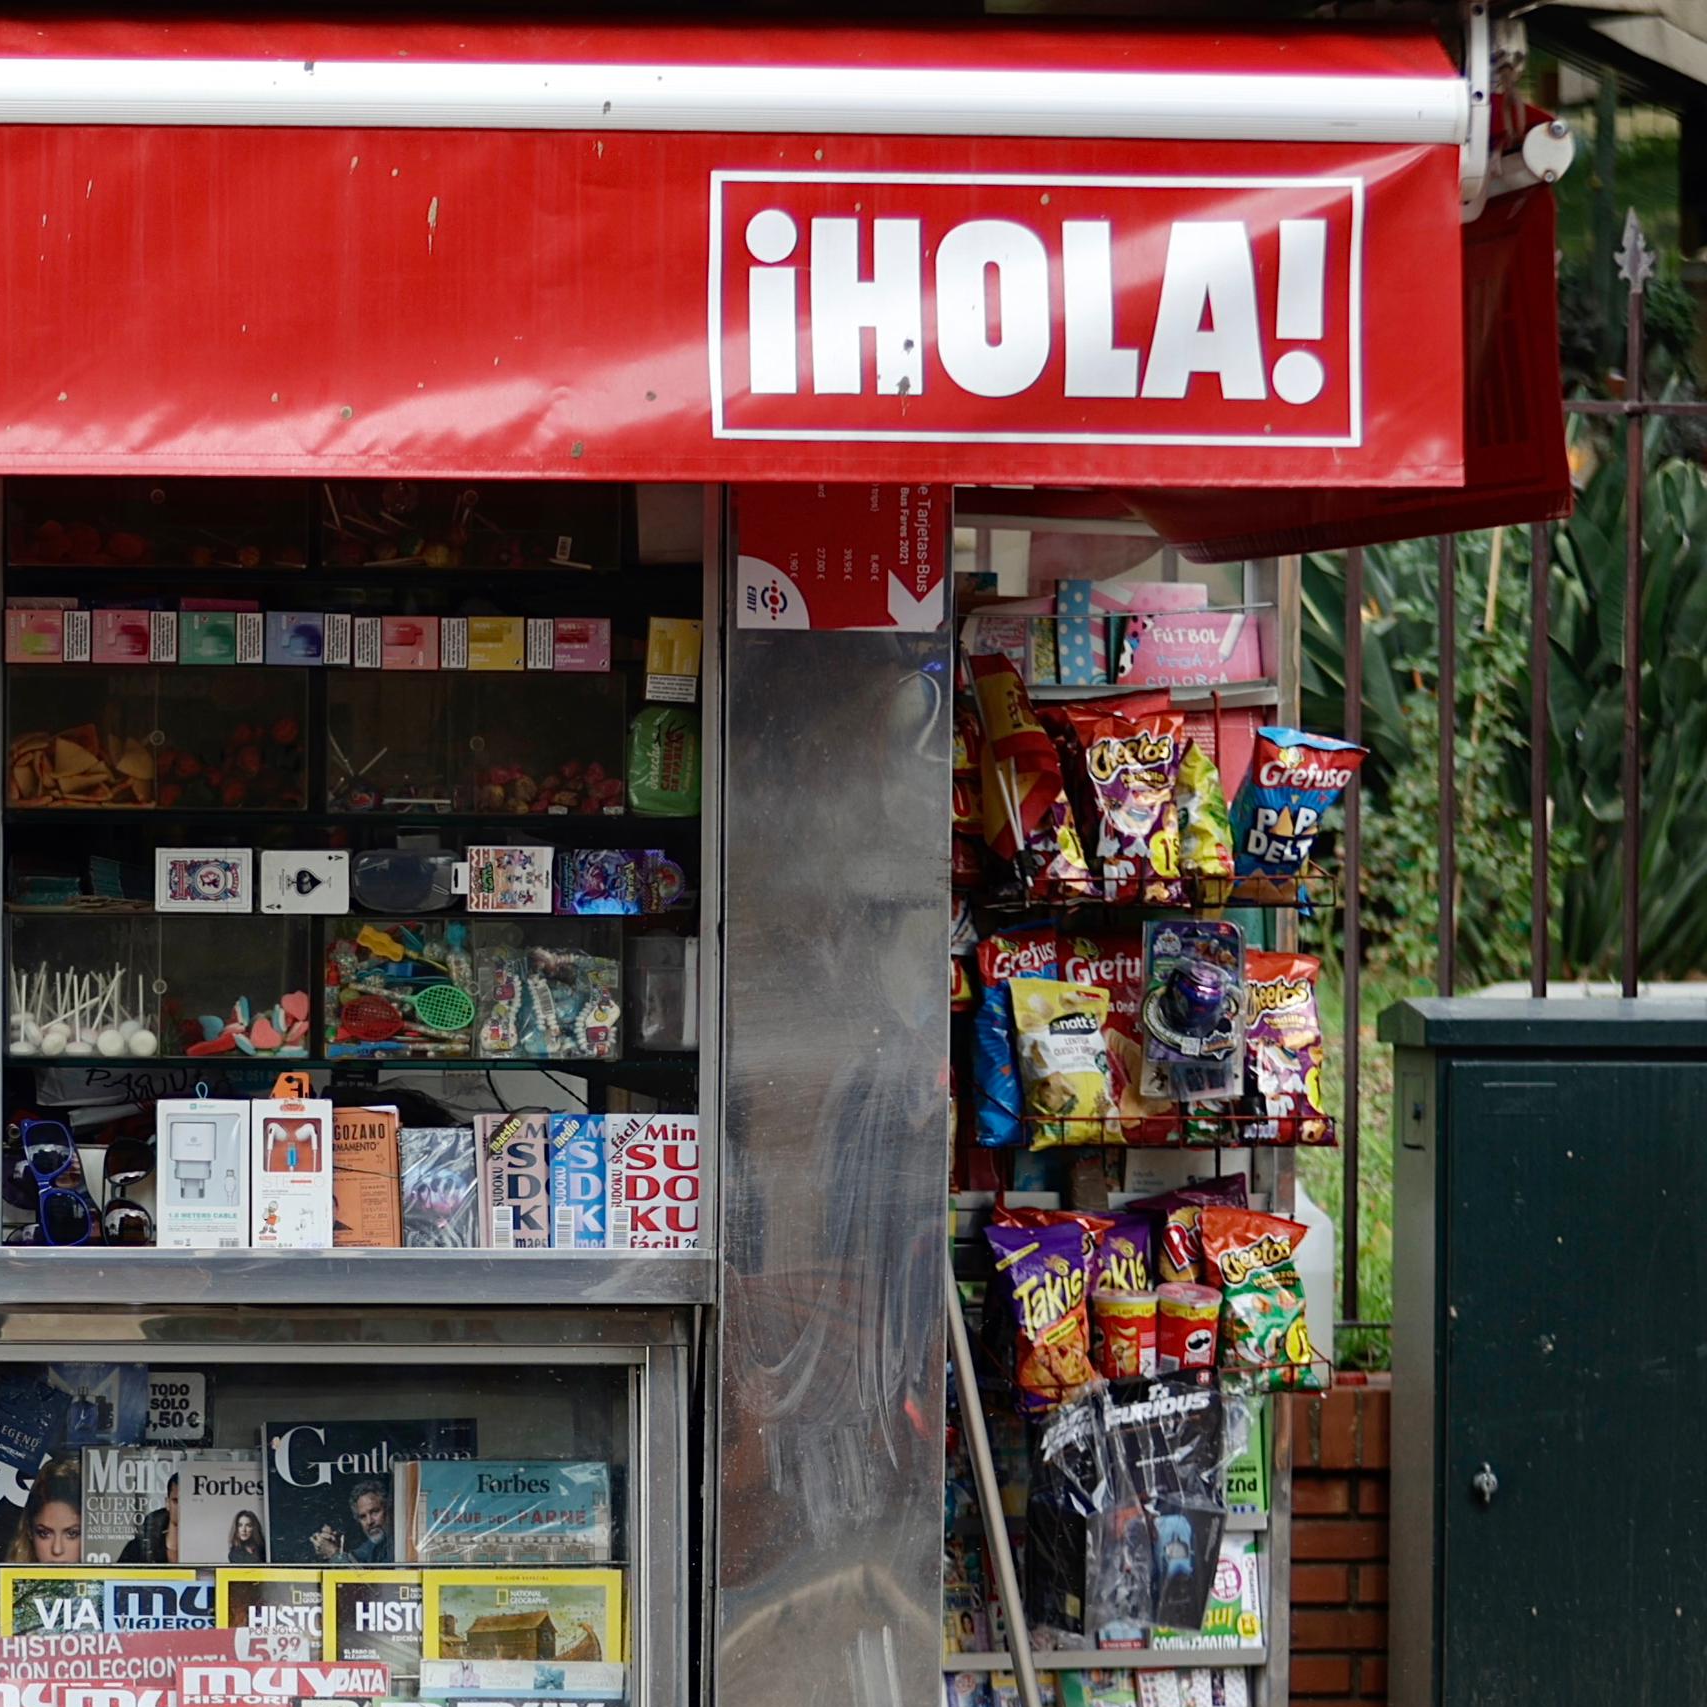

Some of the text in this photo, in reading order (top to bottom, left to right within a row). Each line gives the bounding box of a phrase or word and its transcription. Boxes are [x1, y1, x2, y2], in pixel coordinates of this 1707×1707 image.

[745, 208, 1328, 405] ¡HOLA!
[899, 487, 910, 565] Bus Fares 2021
[914, 499, 931, 593] Tarjetas-Bus
[1152, 627, 1220, 646] FÚTBOL
[1089, 731, 1173, 784] Cheetos
[1259, 761, 1352, 789] Grefusa
[1065, 953, 1142, 986] Grefu
[334, 1122, 386, 1140] GOZANO
[490, 1117, 522, 1152] maestro
[554, 1120, 581, 1149] medio
[610, 1118, 641, 1149] fácil
[644, 1123, 696, 1141] Min
[625, 1144, 699, 1171] SU
[625, 1175, 699, 1202] DO
[630, 1206, 699, 1232] KU
[1219, 1233, 1291, 1284] Cheetos
[1013, 1265, 1087, 1343] Takis
[149, 1384, 190, 1396] TODO
[149, 1395, 190, 1410] SÓLO
[88, 1450, 173, 1494] Men's
[192, 1474, 264, 1496] Forbes
[477, 1473, 550, 1494] Forbes
[88, 1512, 145, 1525] NUEVO
[509, 1590, 541, 1598] NATIONAL
[510, 1597, 549, 1605] GEOGRAPHIC
[114, 1617, 215, 1630] VIAJEROS
[11, 1634, 123, 1658] HISTORIA
[337, 1668, 386, 1693] DATA
